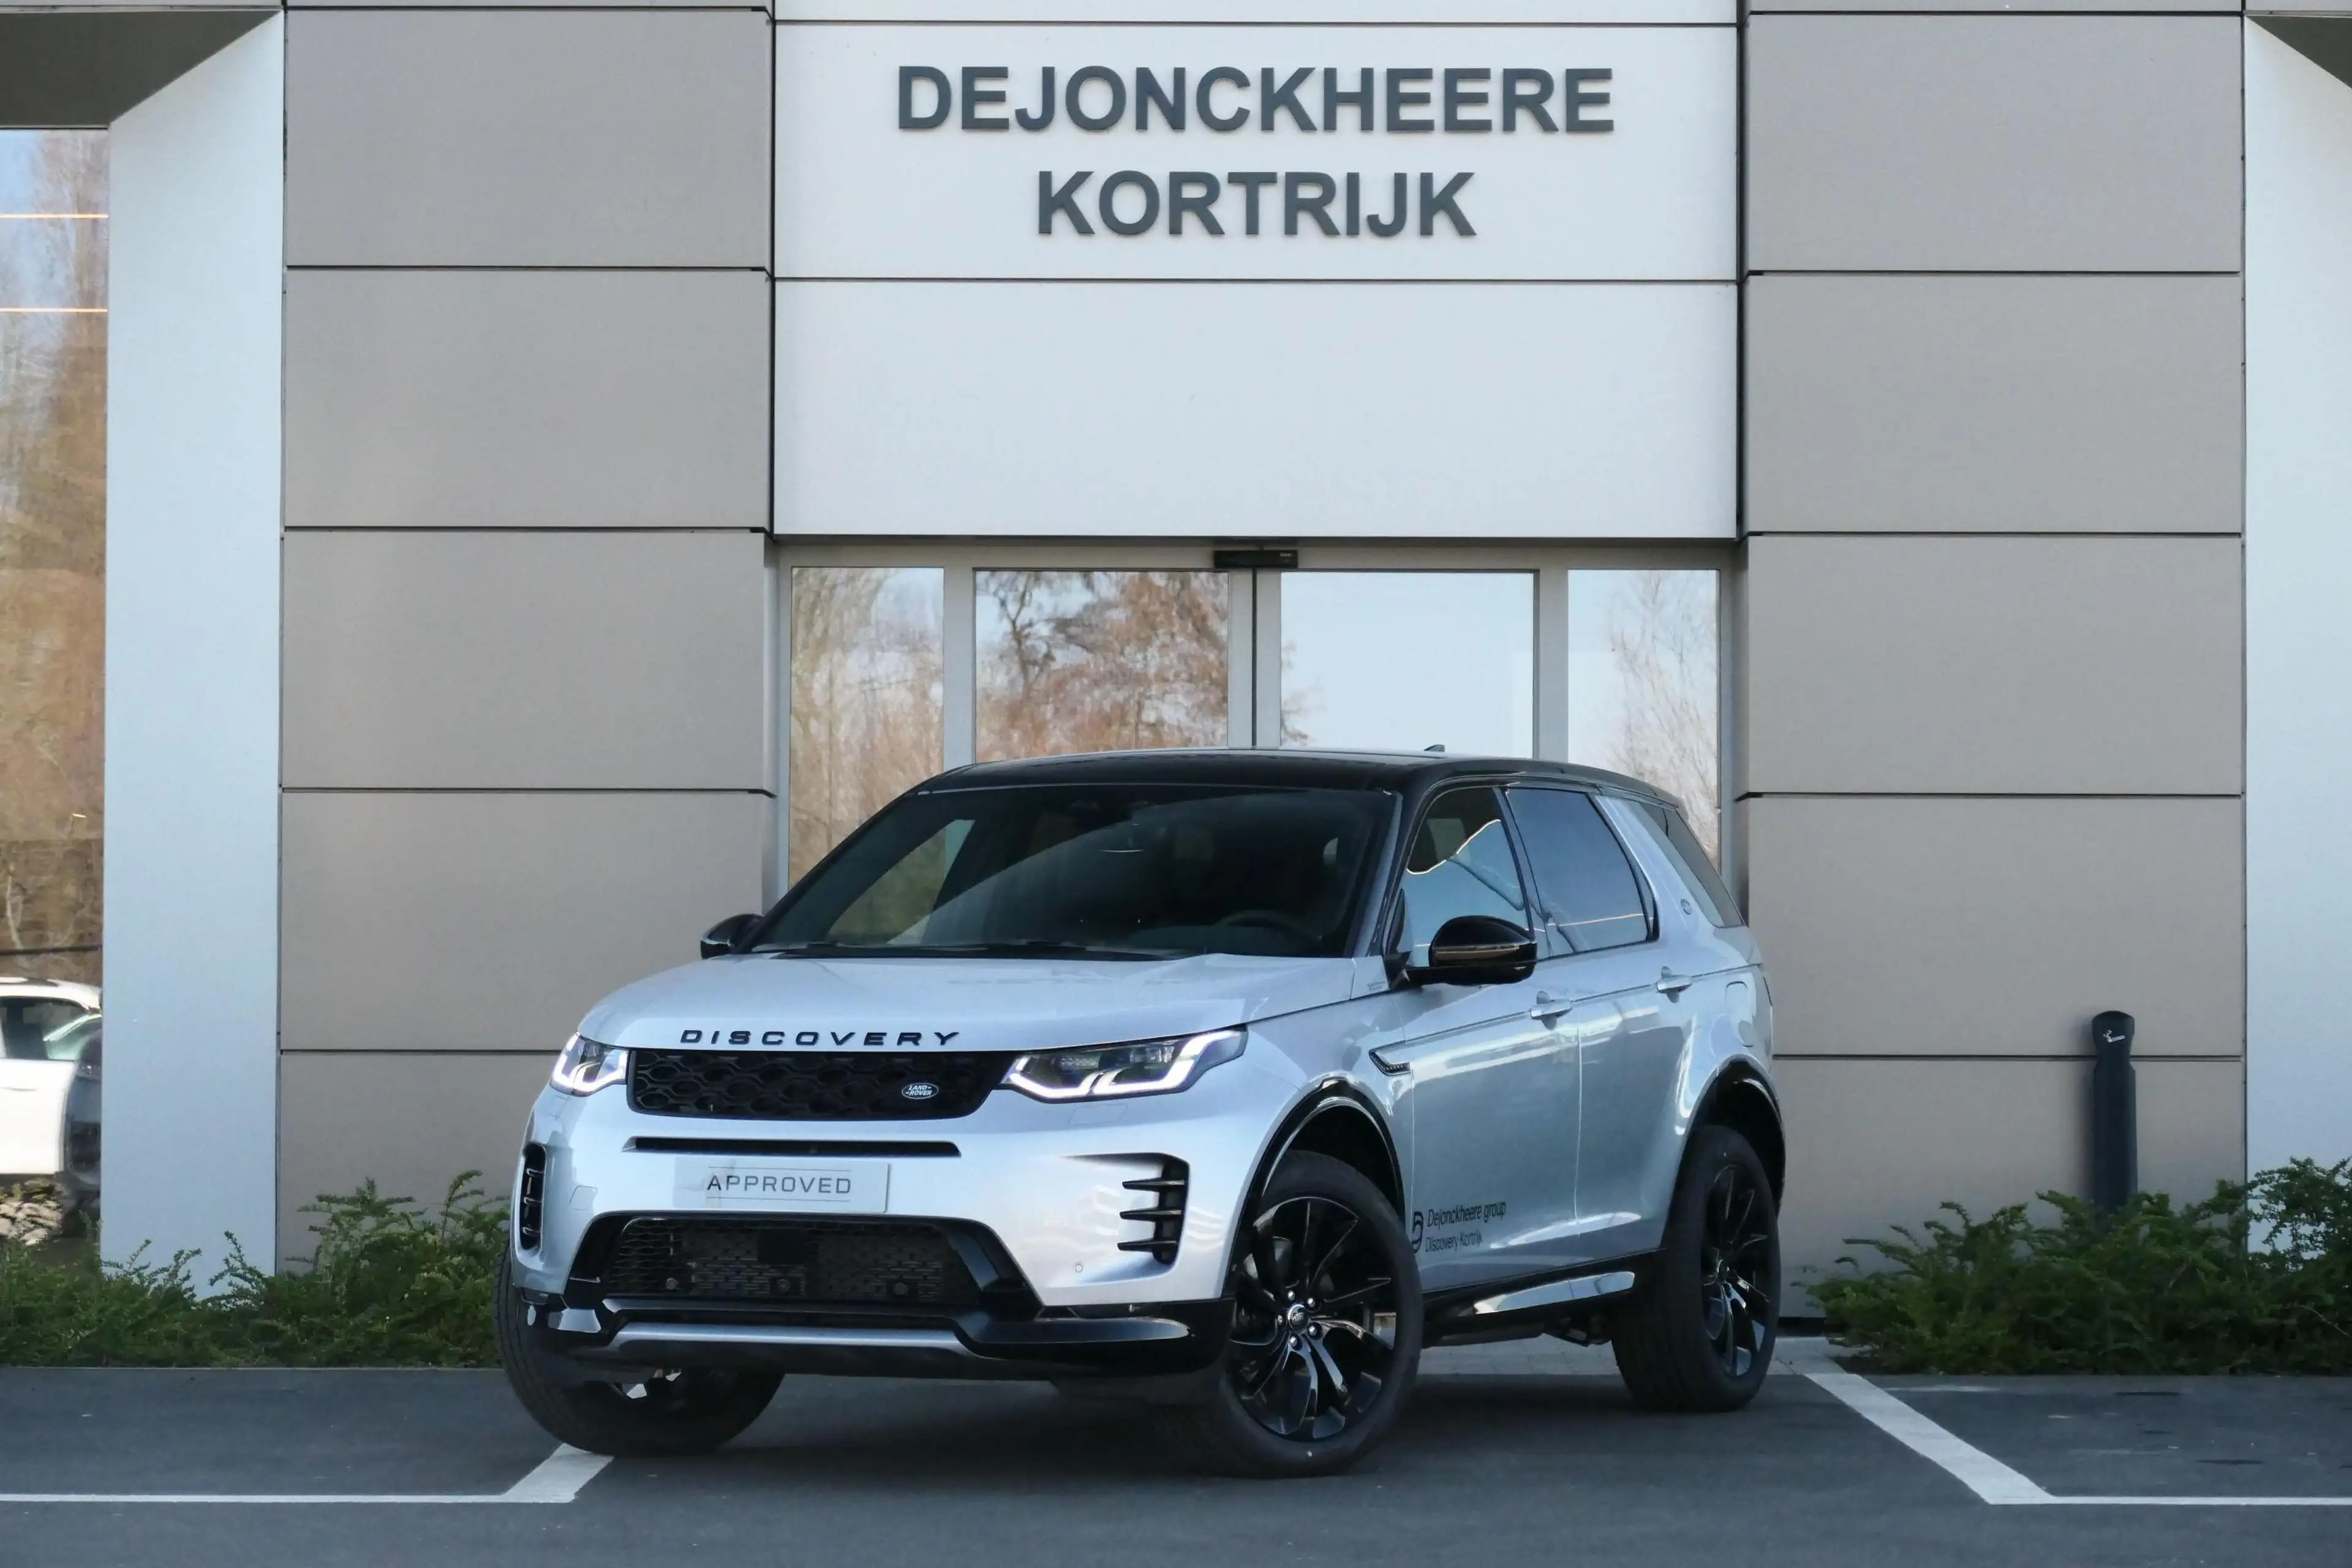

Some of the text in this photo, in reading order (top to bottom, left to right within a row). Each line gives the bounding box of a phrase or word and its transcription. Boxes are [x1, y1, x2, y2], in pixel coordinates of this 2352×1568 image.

[898, 66, 1614, 132] DEJONCKHEERE
[1038, 170, 1477, 236] KORTRIJK
[680, 1030, 959, 1046] DISCOVERY
[707, 1175, 851, 1194] APPROVED
[1427, 1201, 1506, 1230] Dejonckheere group
[1425, 1236, 1459, 1253] Discovery
